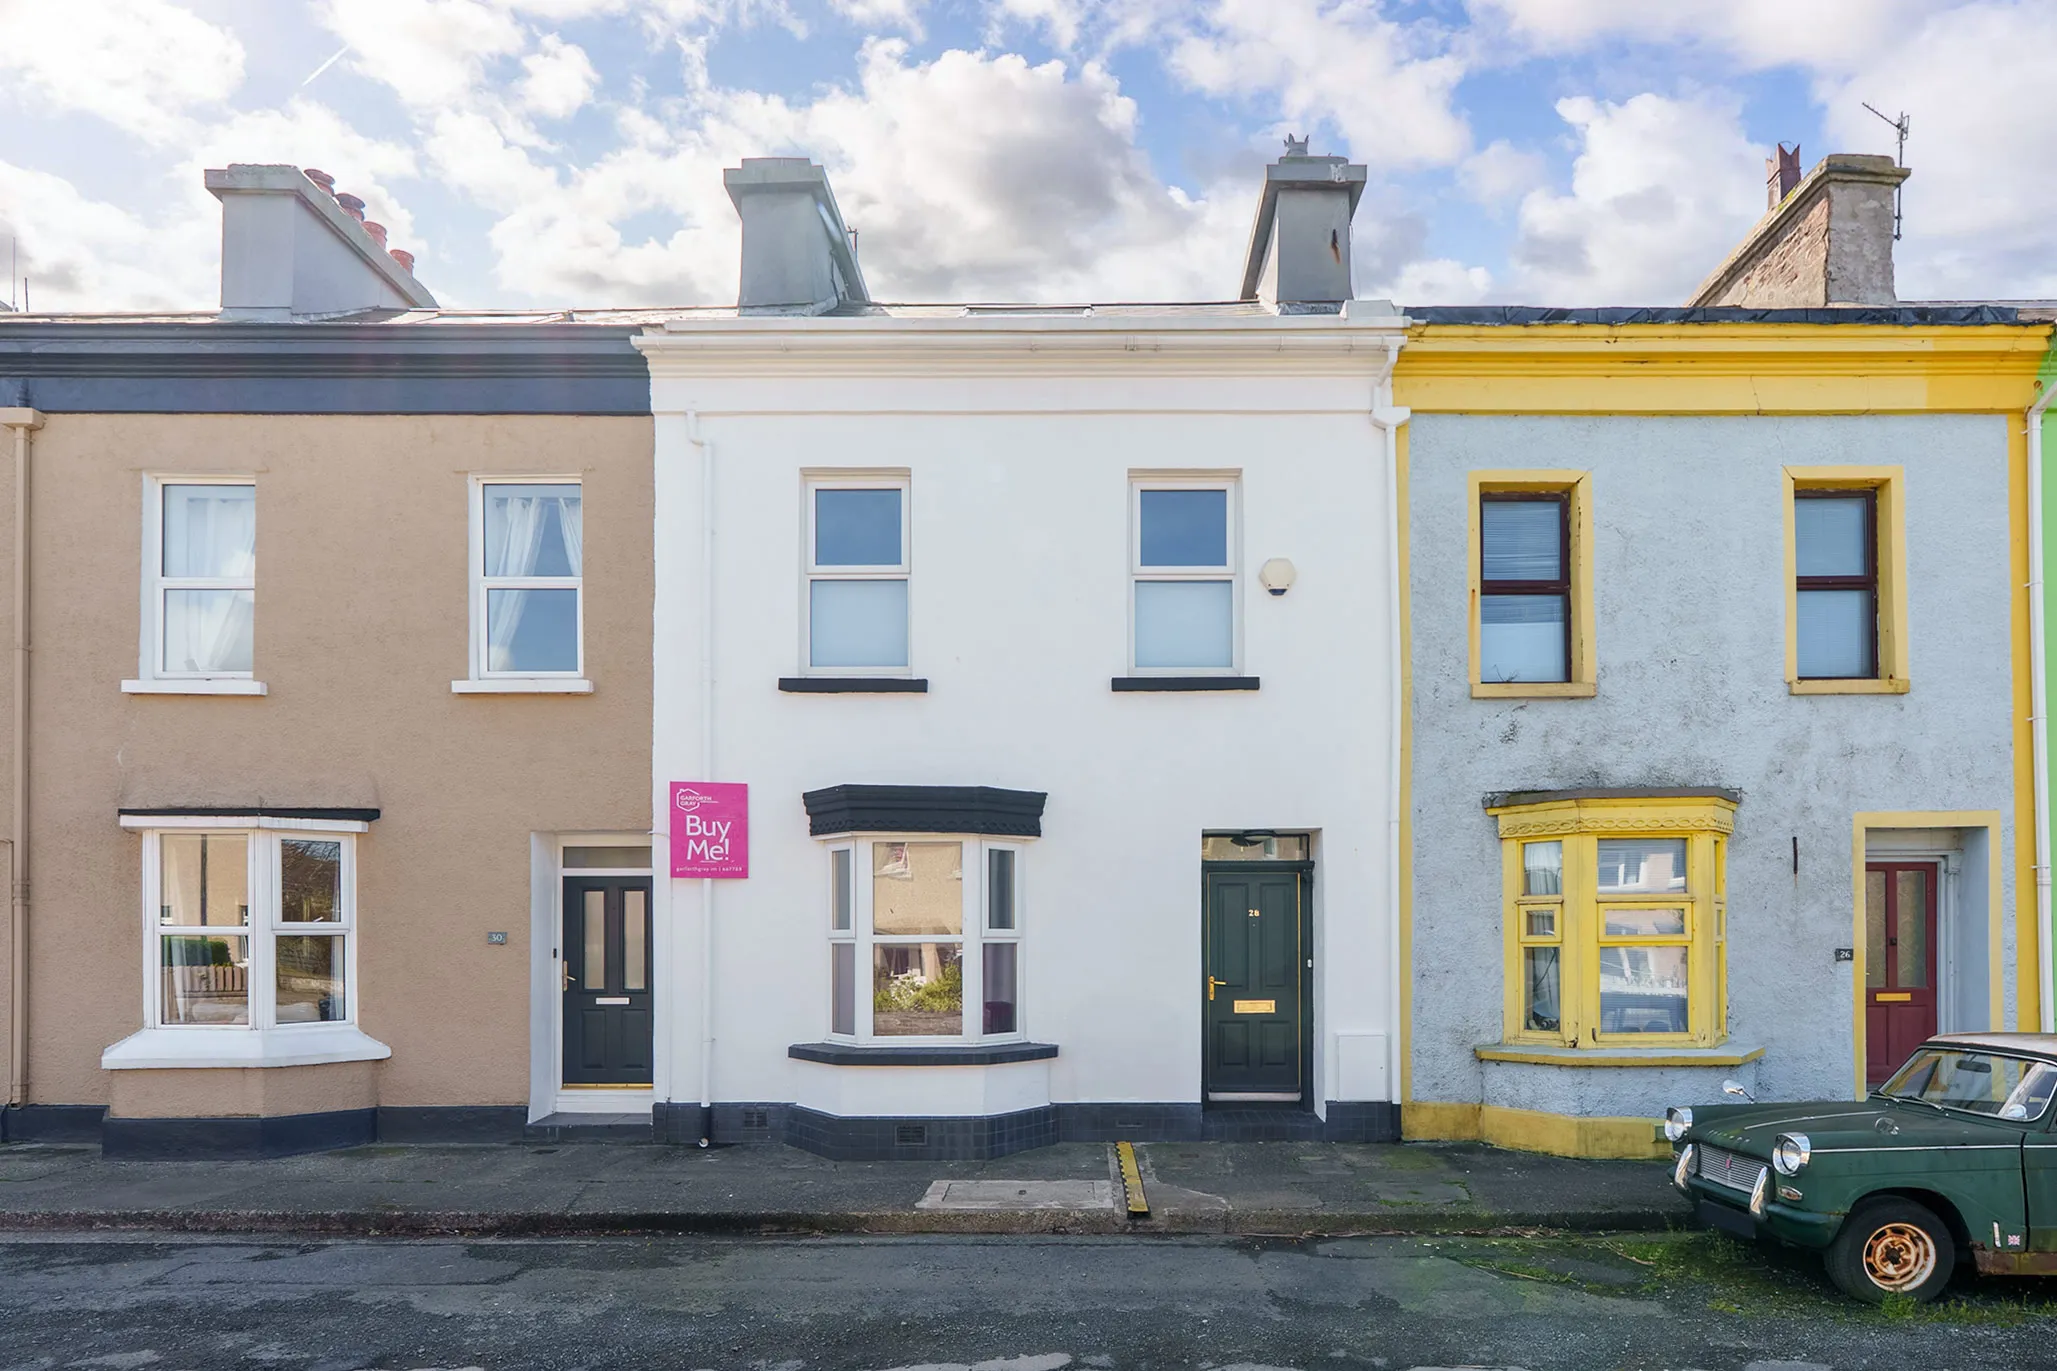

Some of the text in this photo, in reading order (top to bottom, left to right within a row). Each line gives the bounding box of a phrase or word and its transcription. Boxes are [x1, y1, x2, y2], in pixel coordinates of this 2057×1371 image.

[686, 815, 732, 843] Buy
[687, 839, 730, 861] Me!
[1248, 909, 1260, 917] 28
[491, 934, 503, 942] 30
[1840, 950, 1851, 959] 26
